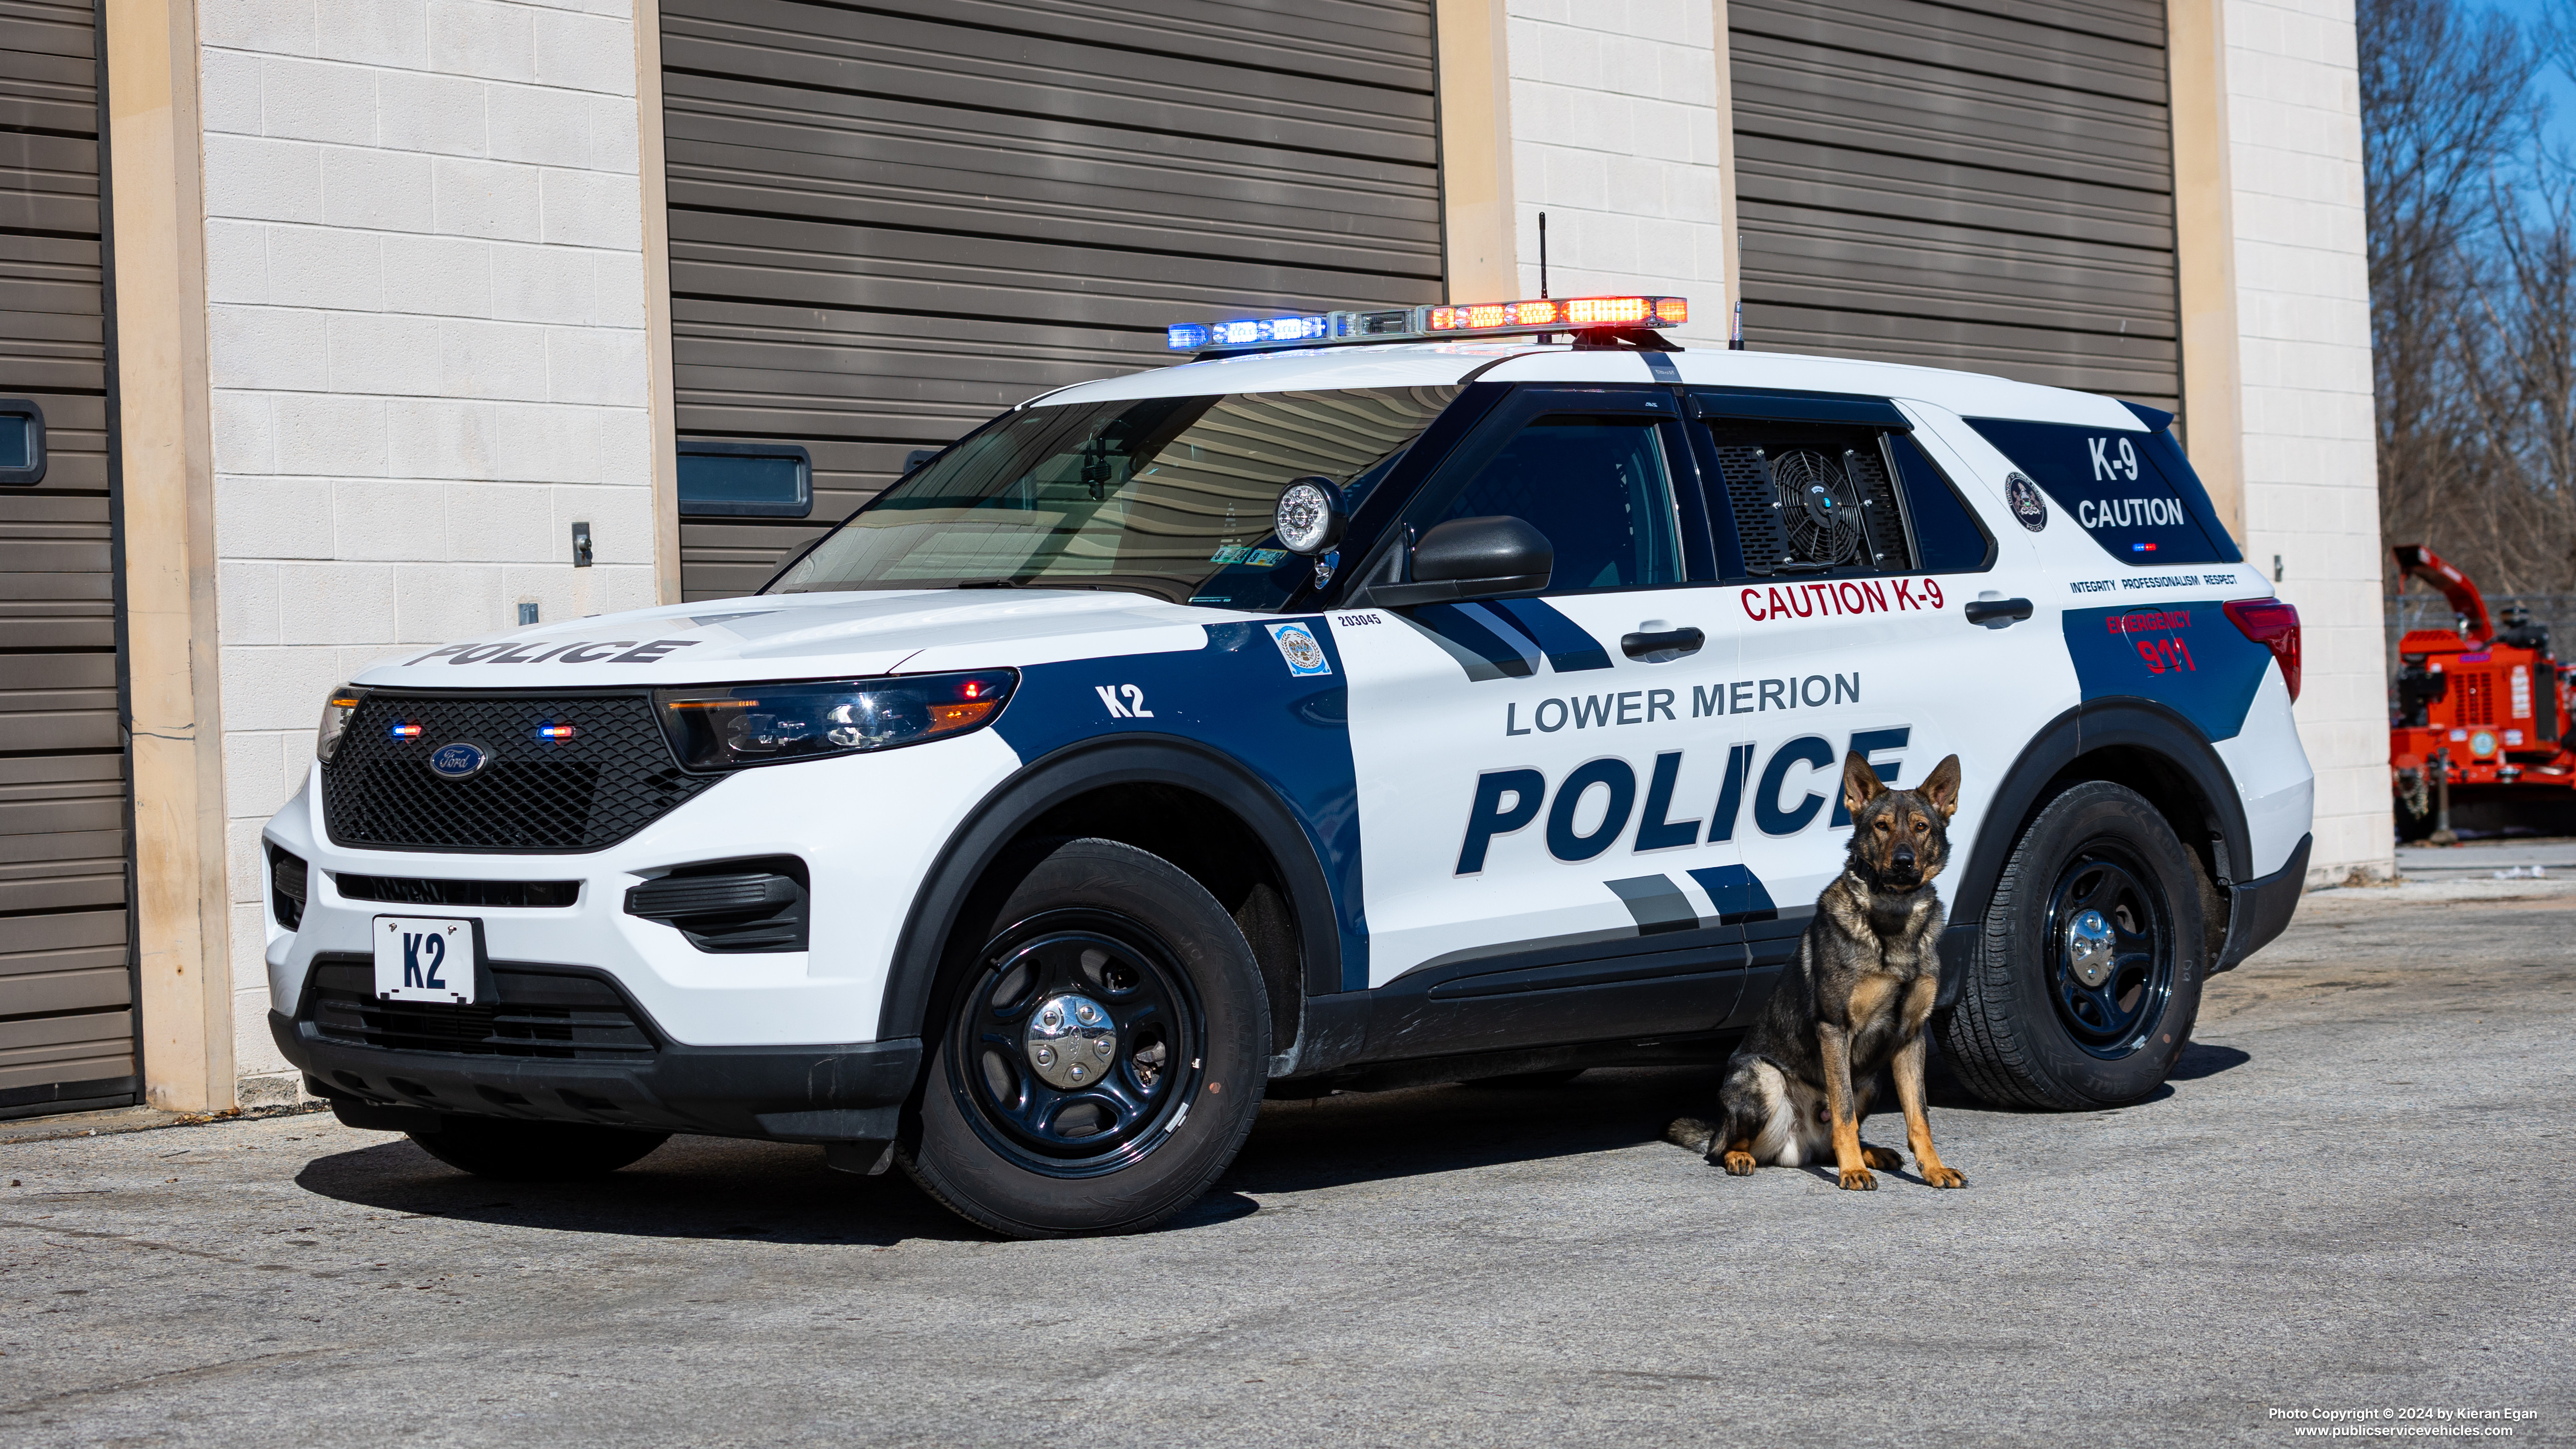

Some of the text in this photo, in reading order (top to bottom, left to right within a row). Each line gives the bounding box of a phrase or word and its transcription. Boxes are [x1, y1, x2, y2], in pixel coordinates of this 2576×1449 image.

[2088, 437, 2138, 481] K-9
[2079, 498, 2185, 528] CAUTION
[1741, 578, 1944, 621] CAUTION K-9
[2070, 574, 2238, 594] INTEGRITY PROFESSIONALISM RESPECT
[1337, 613, 1382, 627] 203045
[2106, 610, 2192, 634] EMERGENCY
[401, 640, 702, 667] POLICE
[2137, 637, 2196, 674] 911
[1094, 683, 1155, 718] K2
[1506, 672, 1860, 736] LOWER MERION
[439, 749, 471, 768] Ford
[1453, 723, 1912, 879] POLICE
[403, 932, 446, 990] K2
